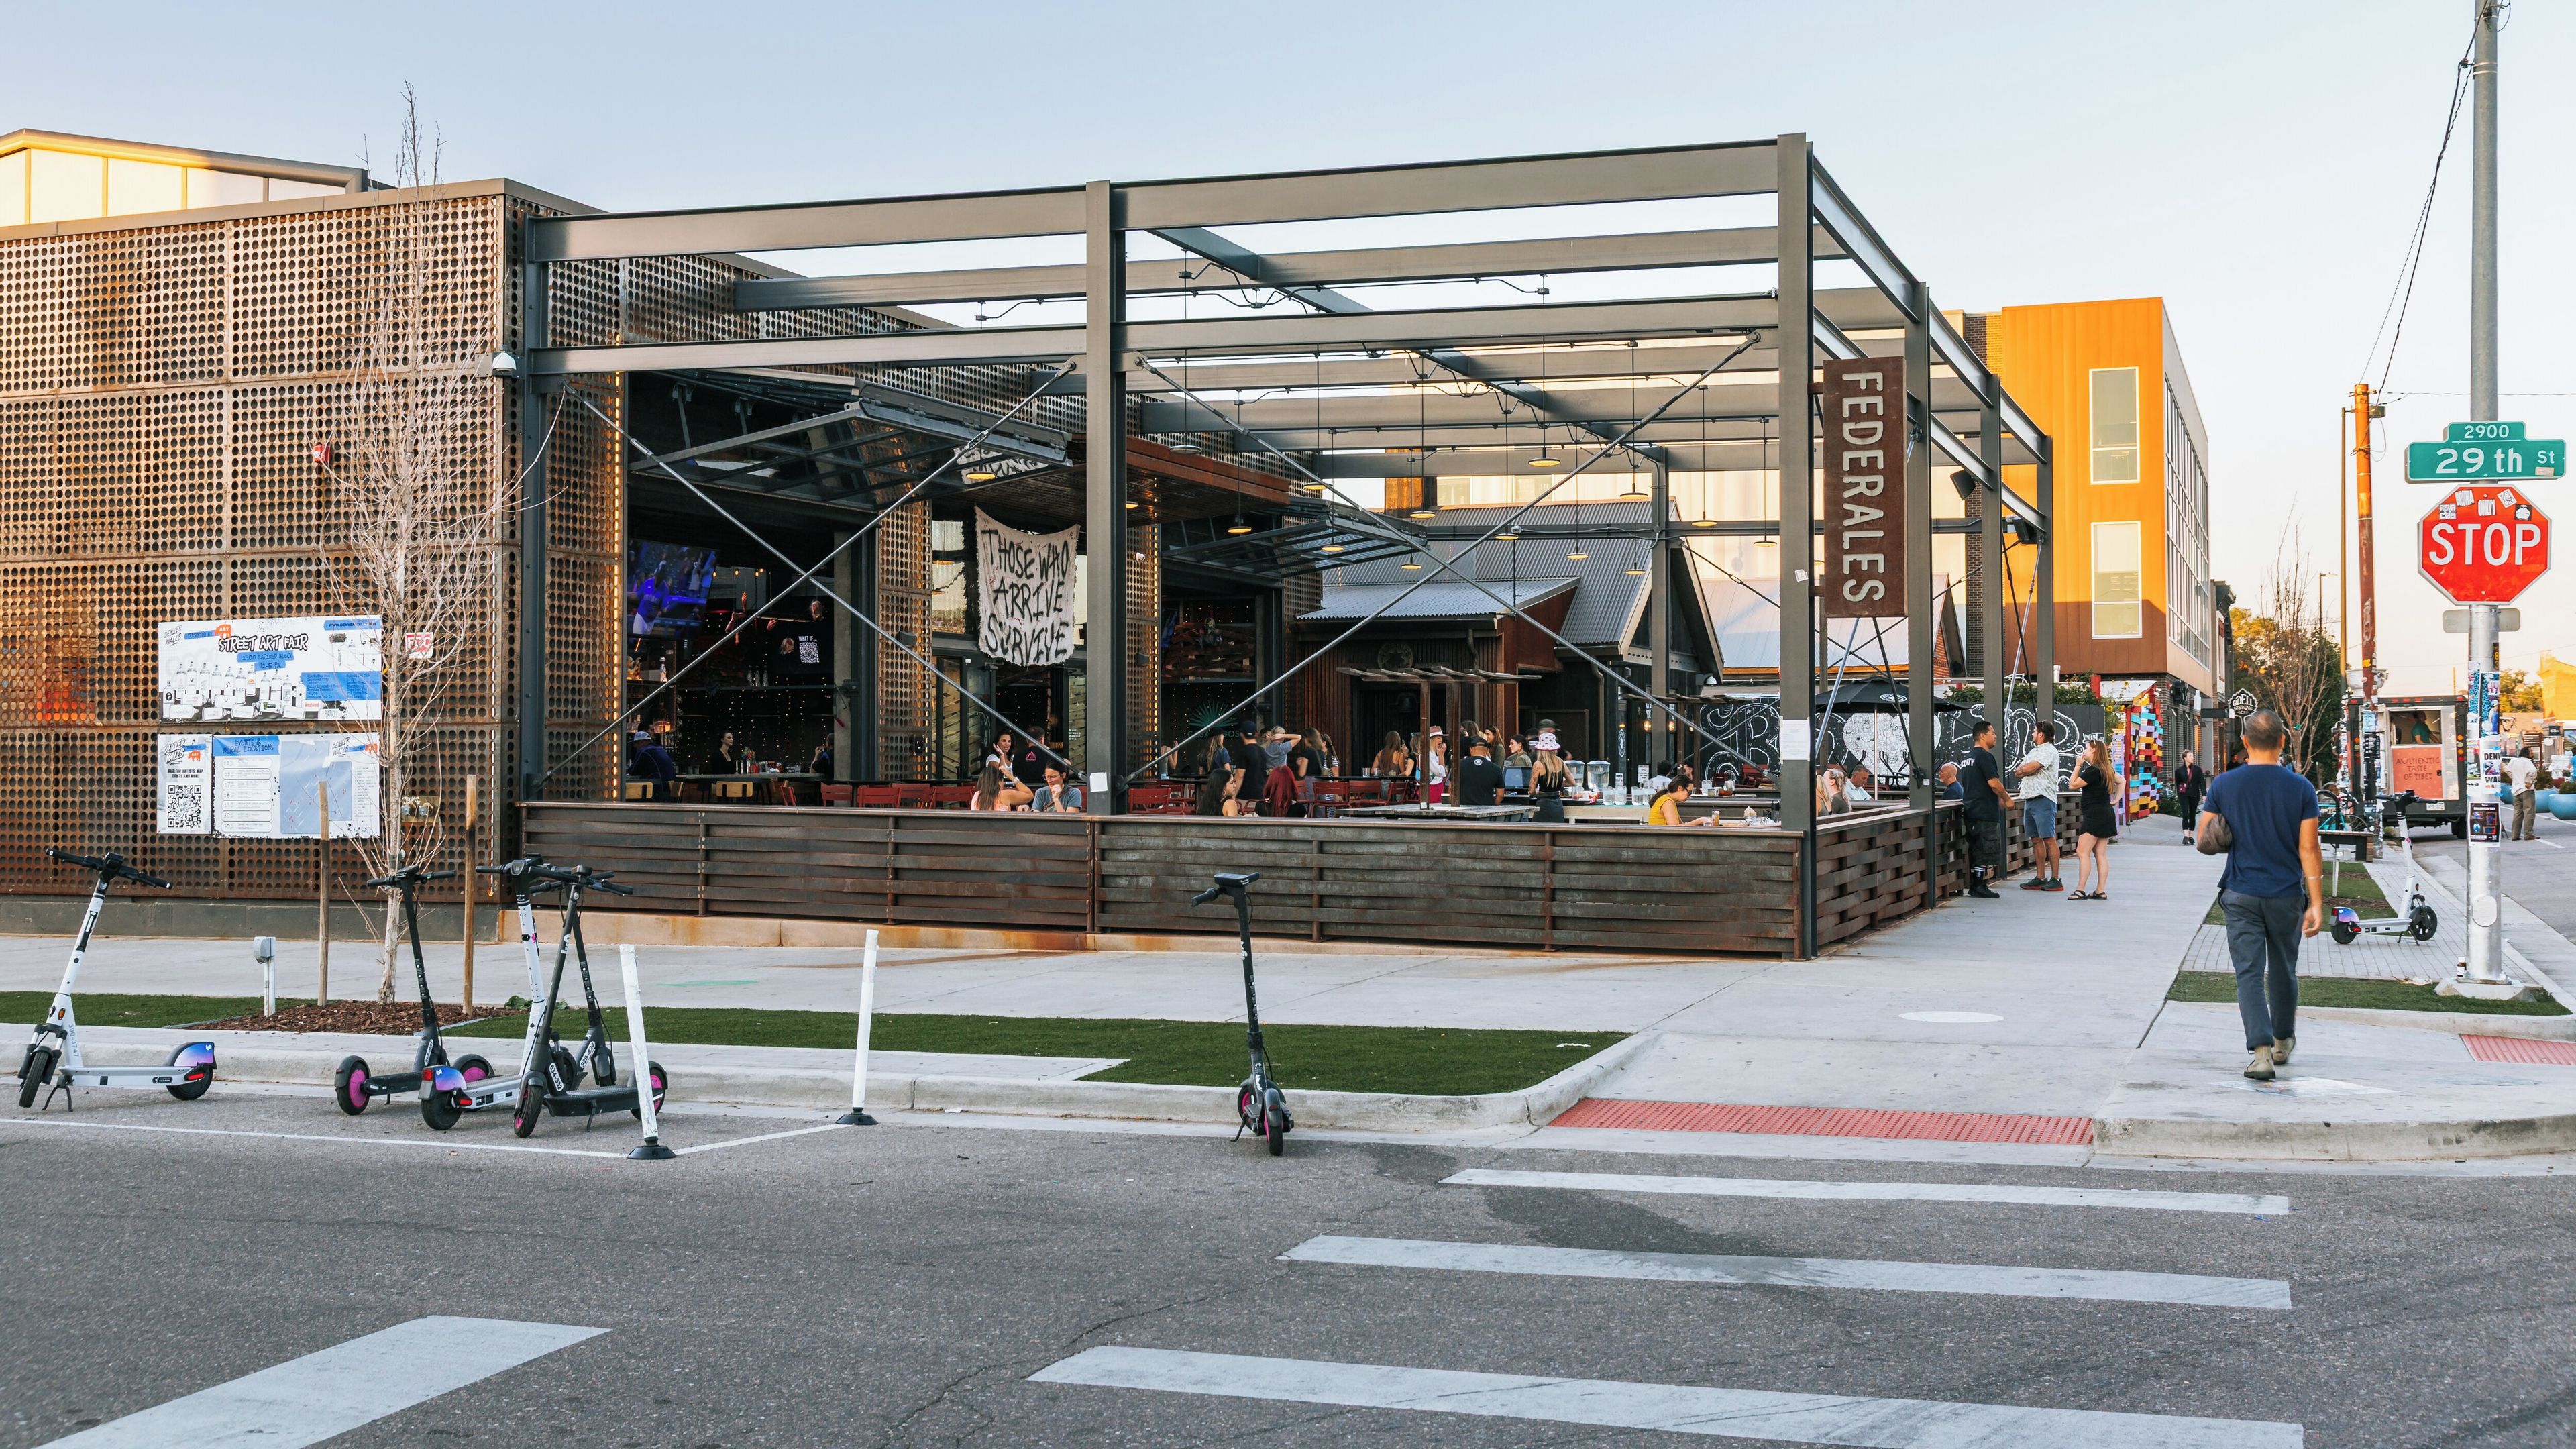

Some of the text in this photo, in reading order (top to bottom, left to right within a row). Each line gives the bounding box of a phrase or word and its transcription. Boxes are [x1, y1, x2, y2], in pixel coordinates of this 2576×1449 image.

[2464, 425, 2510, 439] 2900
[2537, 450, 2555, 464] St
[1841, 372, 1886, 602] FEDERALES
[981, 528, 1069, 582] THOSE WHO
[2428, 523, 2542, 567] STOP
[993, 576, 1065, 623] ARRIVE
[219, 633, 309, 653] STREET ART FAIR
[985, 613, 1069, 664] SURVIVE
[2233, 694, 2253, 706] ODELL
[164, 738, 186, 754] DENVER
[223, 744, 274, 753] MURAL LOCATIONS
[2396, 757, 2440, 765] AUTHENTIC
[68, 1024, 79, 1057] 390-3747
[580, 1042, 595, 1067] 929-824
[549, 1064, 563, 1091] 634-532
